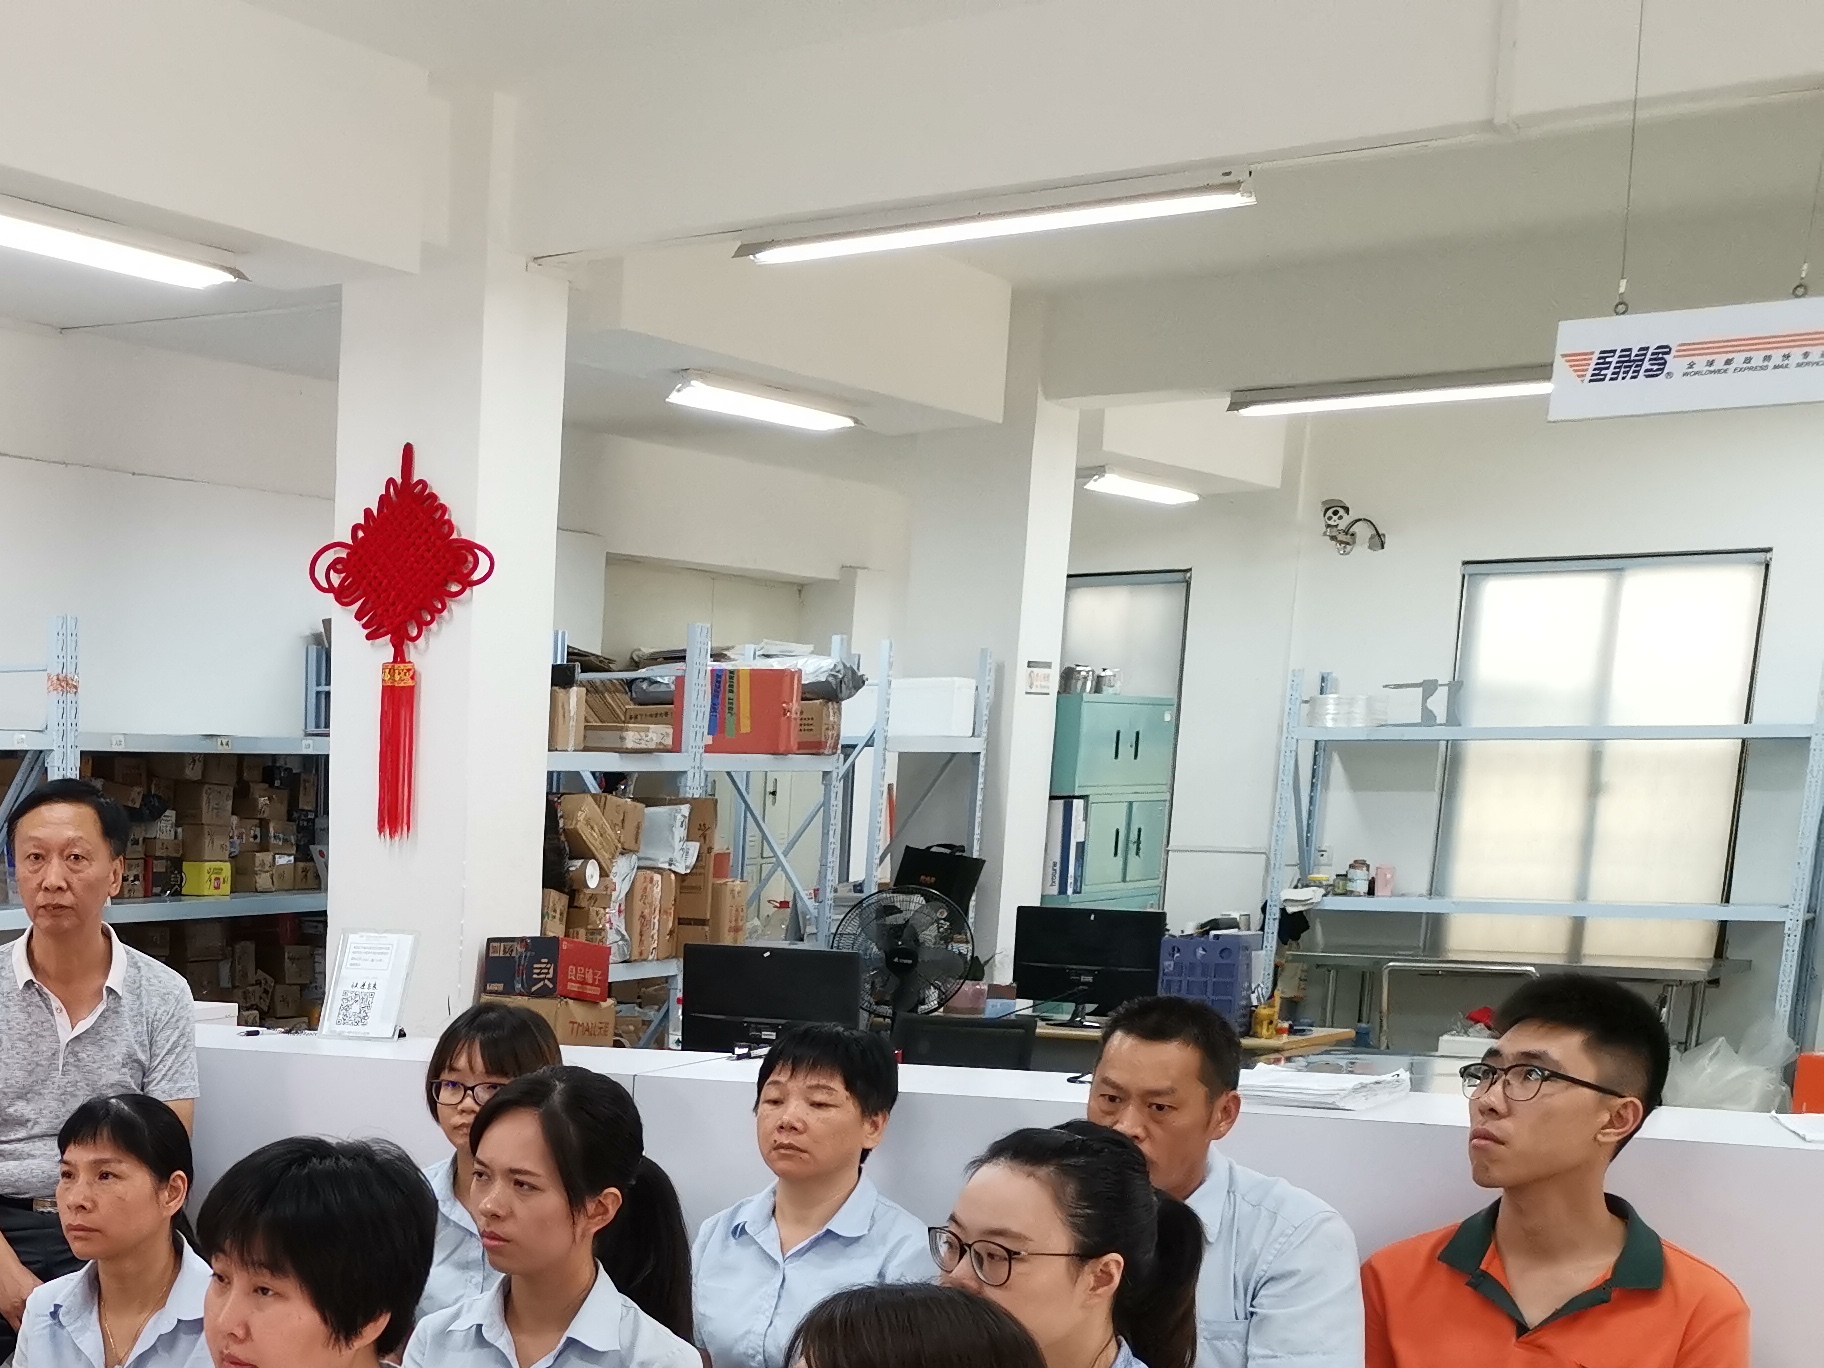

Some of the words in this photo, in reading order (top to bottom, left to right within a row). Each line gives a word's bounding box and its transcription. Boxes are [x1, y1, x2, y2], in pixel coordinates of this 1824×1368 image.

[1588, 344, 1672, 384] EMS
[1682, 367, 1730, 378] WORLDWIDE
[1733, 364, 1769, 374] EXPRESS
[567, 965, 603, 985] 良品铺子
